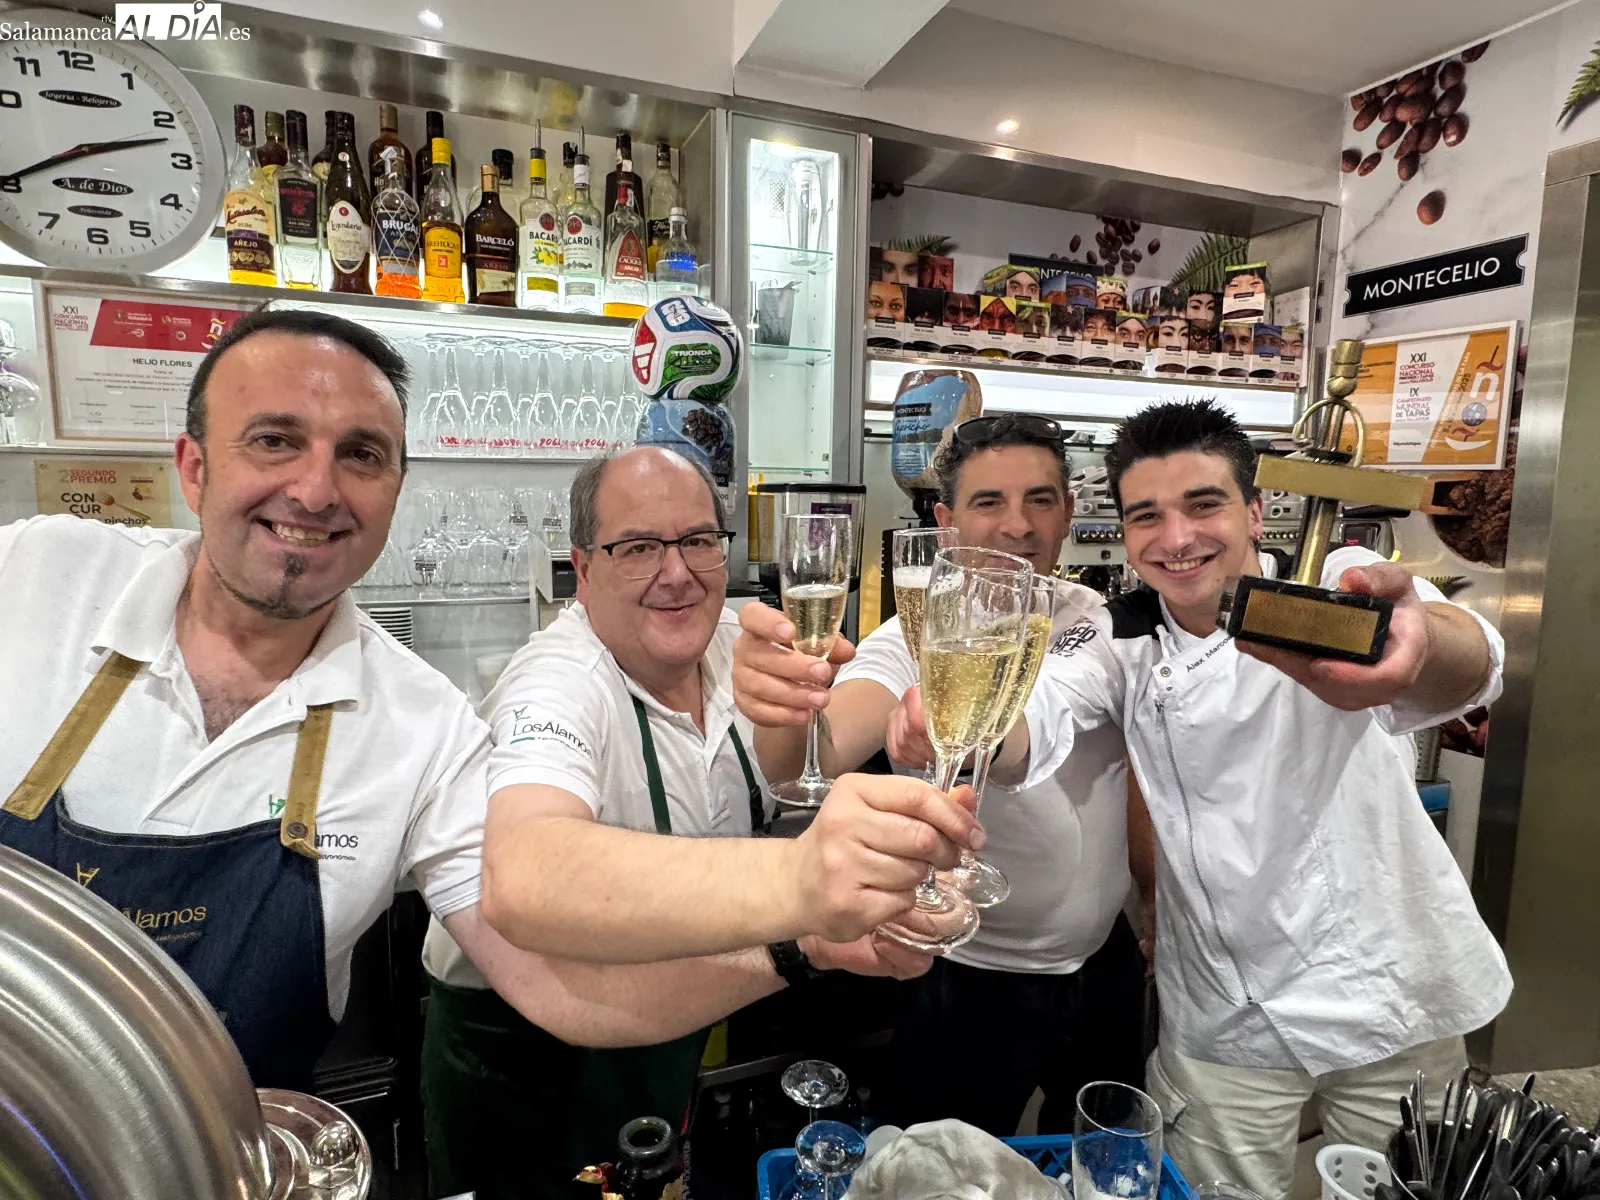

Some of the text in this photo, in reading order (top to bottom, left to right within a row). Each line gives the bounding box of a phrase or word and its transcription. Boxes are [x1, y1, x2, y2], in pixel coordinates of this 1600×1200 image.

[57, 50, 95, 71] 12
[13, 56, 41, 77] 11
[121, 72, 134, 90] 1
[152, 110, 176, 129] 2
[171, 152, 193, 170] 3
[99, 181, 128, 194] Dios
[159, 193, 183, 210] 4
[37, 211, 60, 230] 7
[129, 220, 151, 238] 5
[86, 227, 109, 245] 6
[475, 234, 514, 247] BARCELÓ
[233, 239, 258, 248] AÑEJO
[1363, 257, 1501, 301] MONTECELIO
[62, 305, 79, 315] XXI
[674, 349, 713, 357] TRIONDA
[1410, 352, 1427, 363] XXI
[132, 358, 193, 368] HELIO FLORES
[1400, 362, 1435, 370] CONCURSO
[1409, 387, 1420, 397] IX
[1396, 402, 1429, 410] MUNDIAL
[1405, 408, 1430, 417] TAPAS
[69, 469, 116, 477] SEGUNDO
[70, 476, 117, 484] PREMIO
[61, 493, 95, 503] CON
[69, 504, 101, 514] CUR
[105, 516, 147, 525] pinchos
